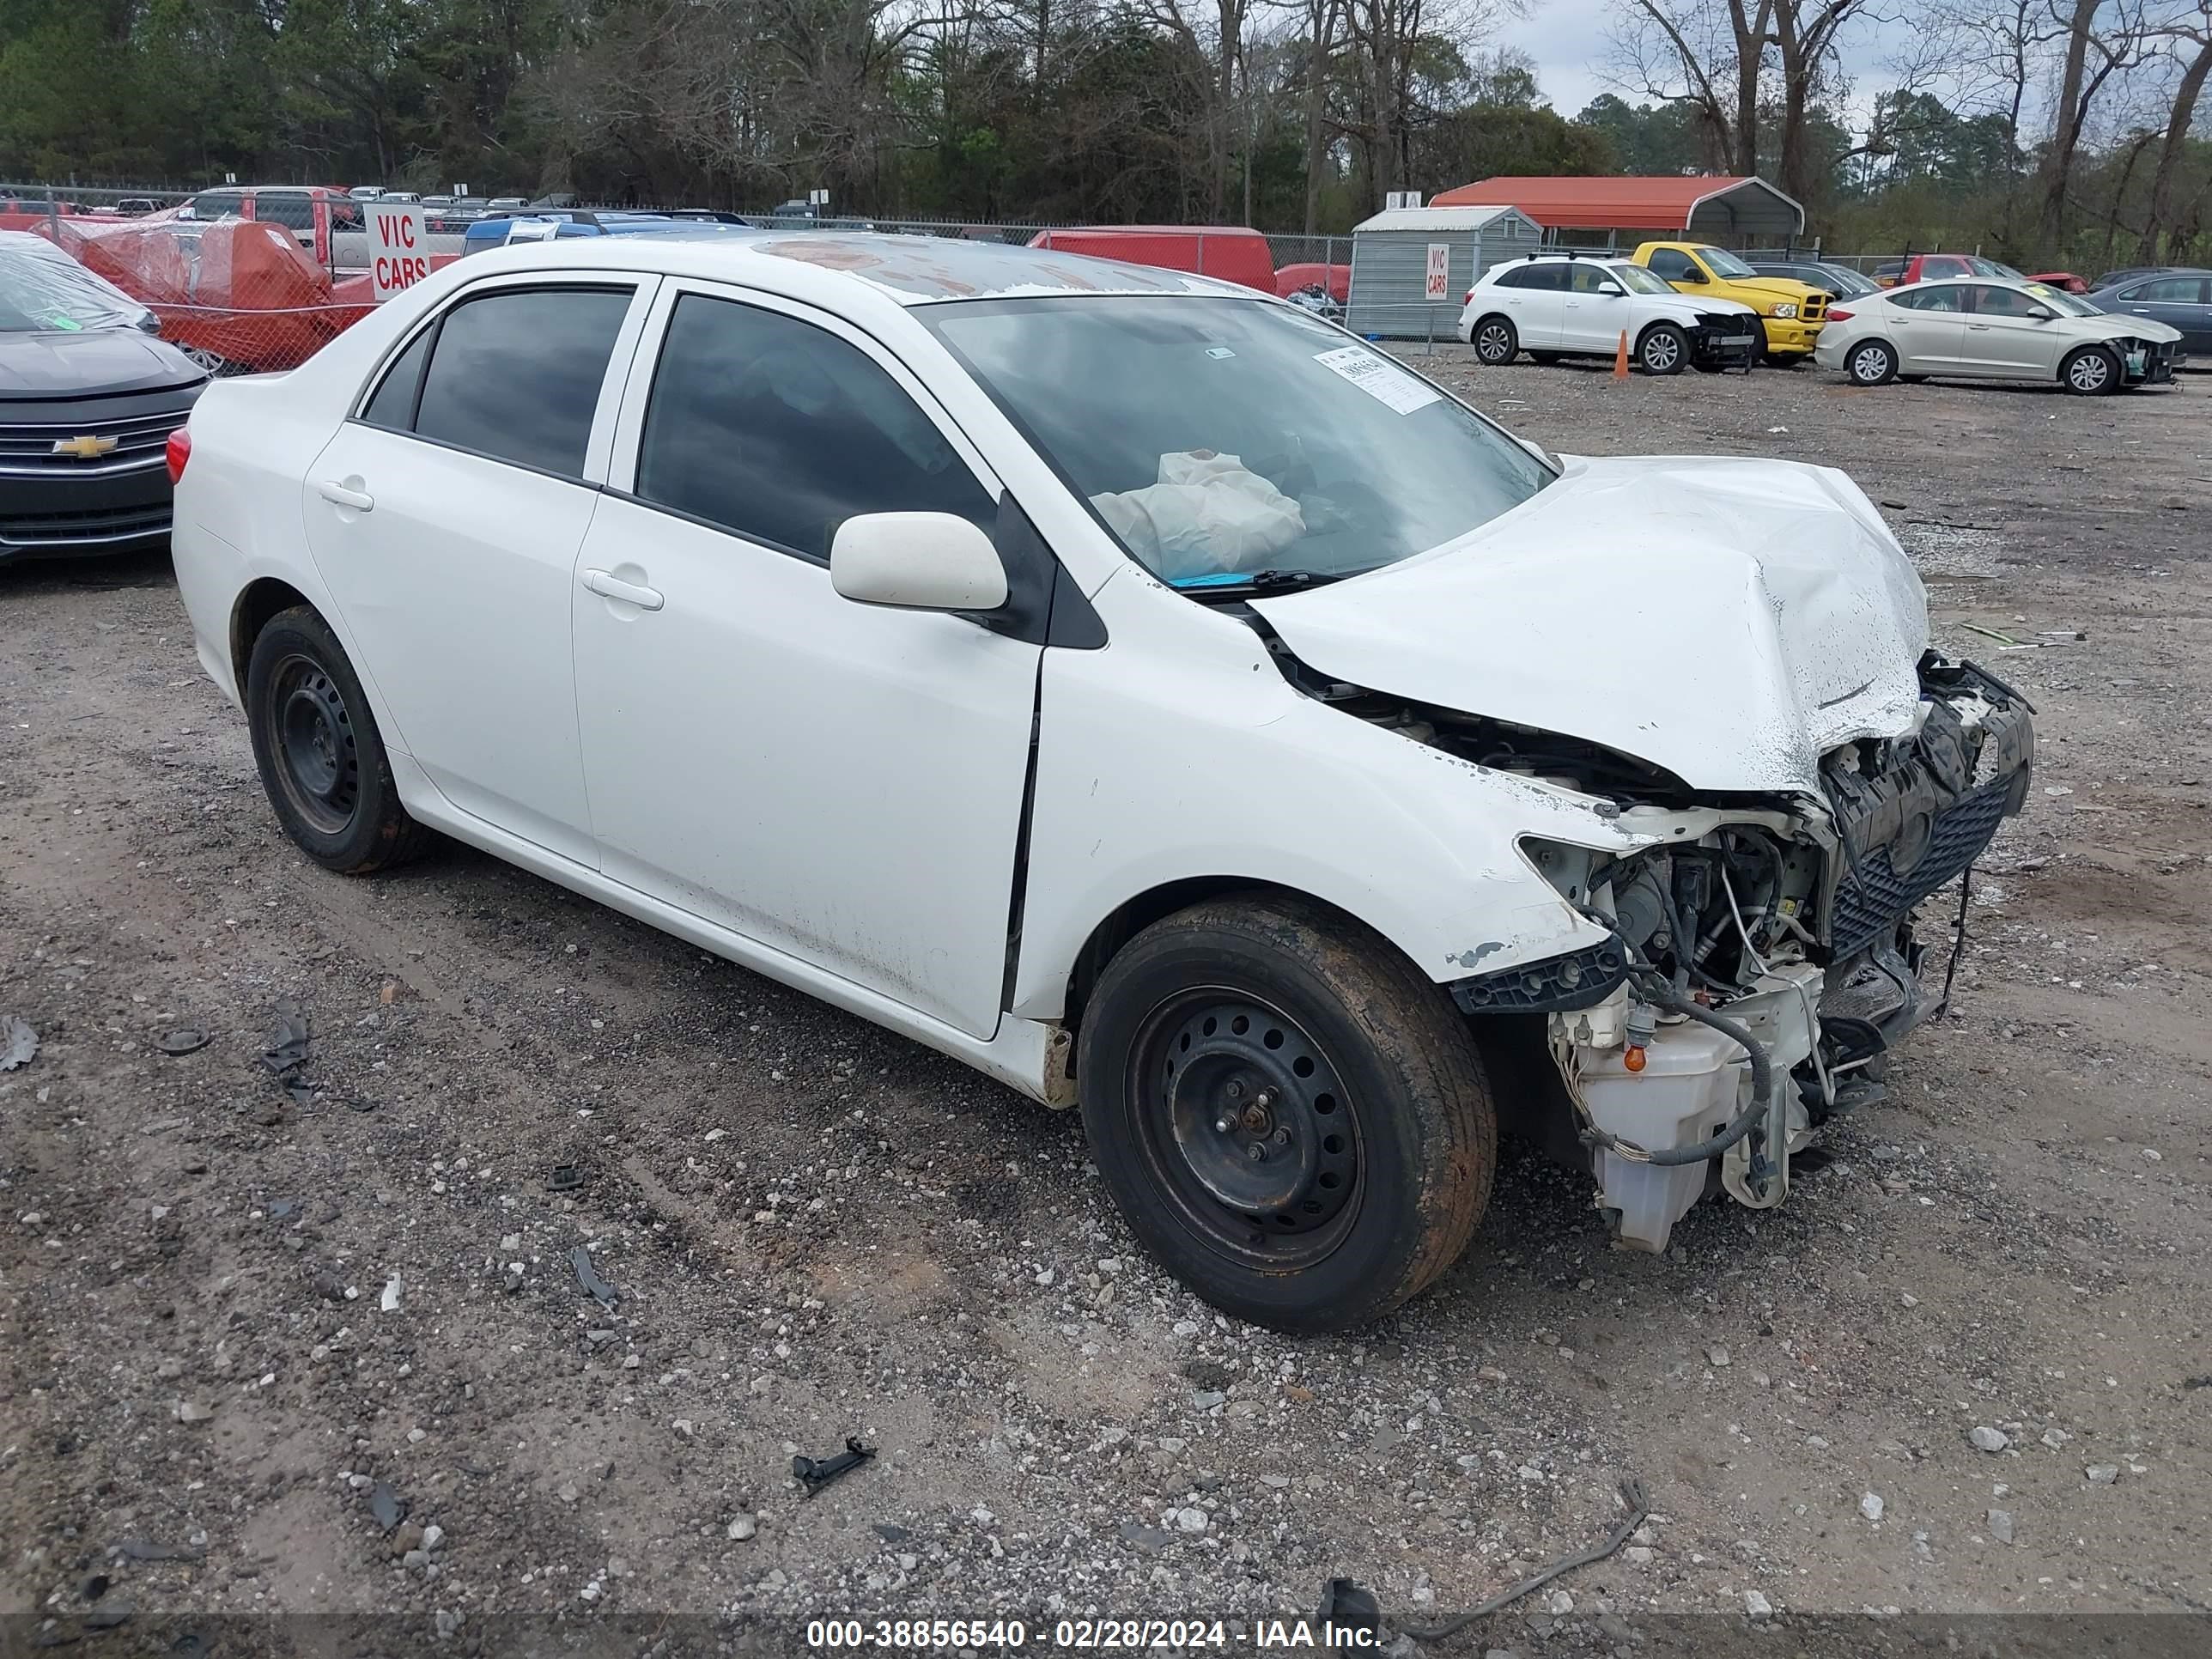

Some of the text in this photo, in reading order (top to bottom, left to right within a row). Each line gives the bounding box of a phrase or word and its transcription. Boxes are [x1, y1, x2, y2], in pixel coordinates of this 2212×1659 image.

[1389, 194, 1397, 207] B
[1408, 193, 1419, 208] A
[377, 215, 415, 248] VIC
[1432, 249, 1445, 269] VIC
[376, 257, 427, 290] CARS
[1427, 274, 1446, 294] CARS
